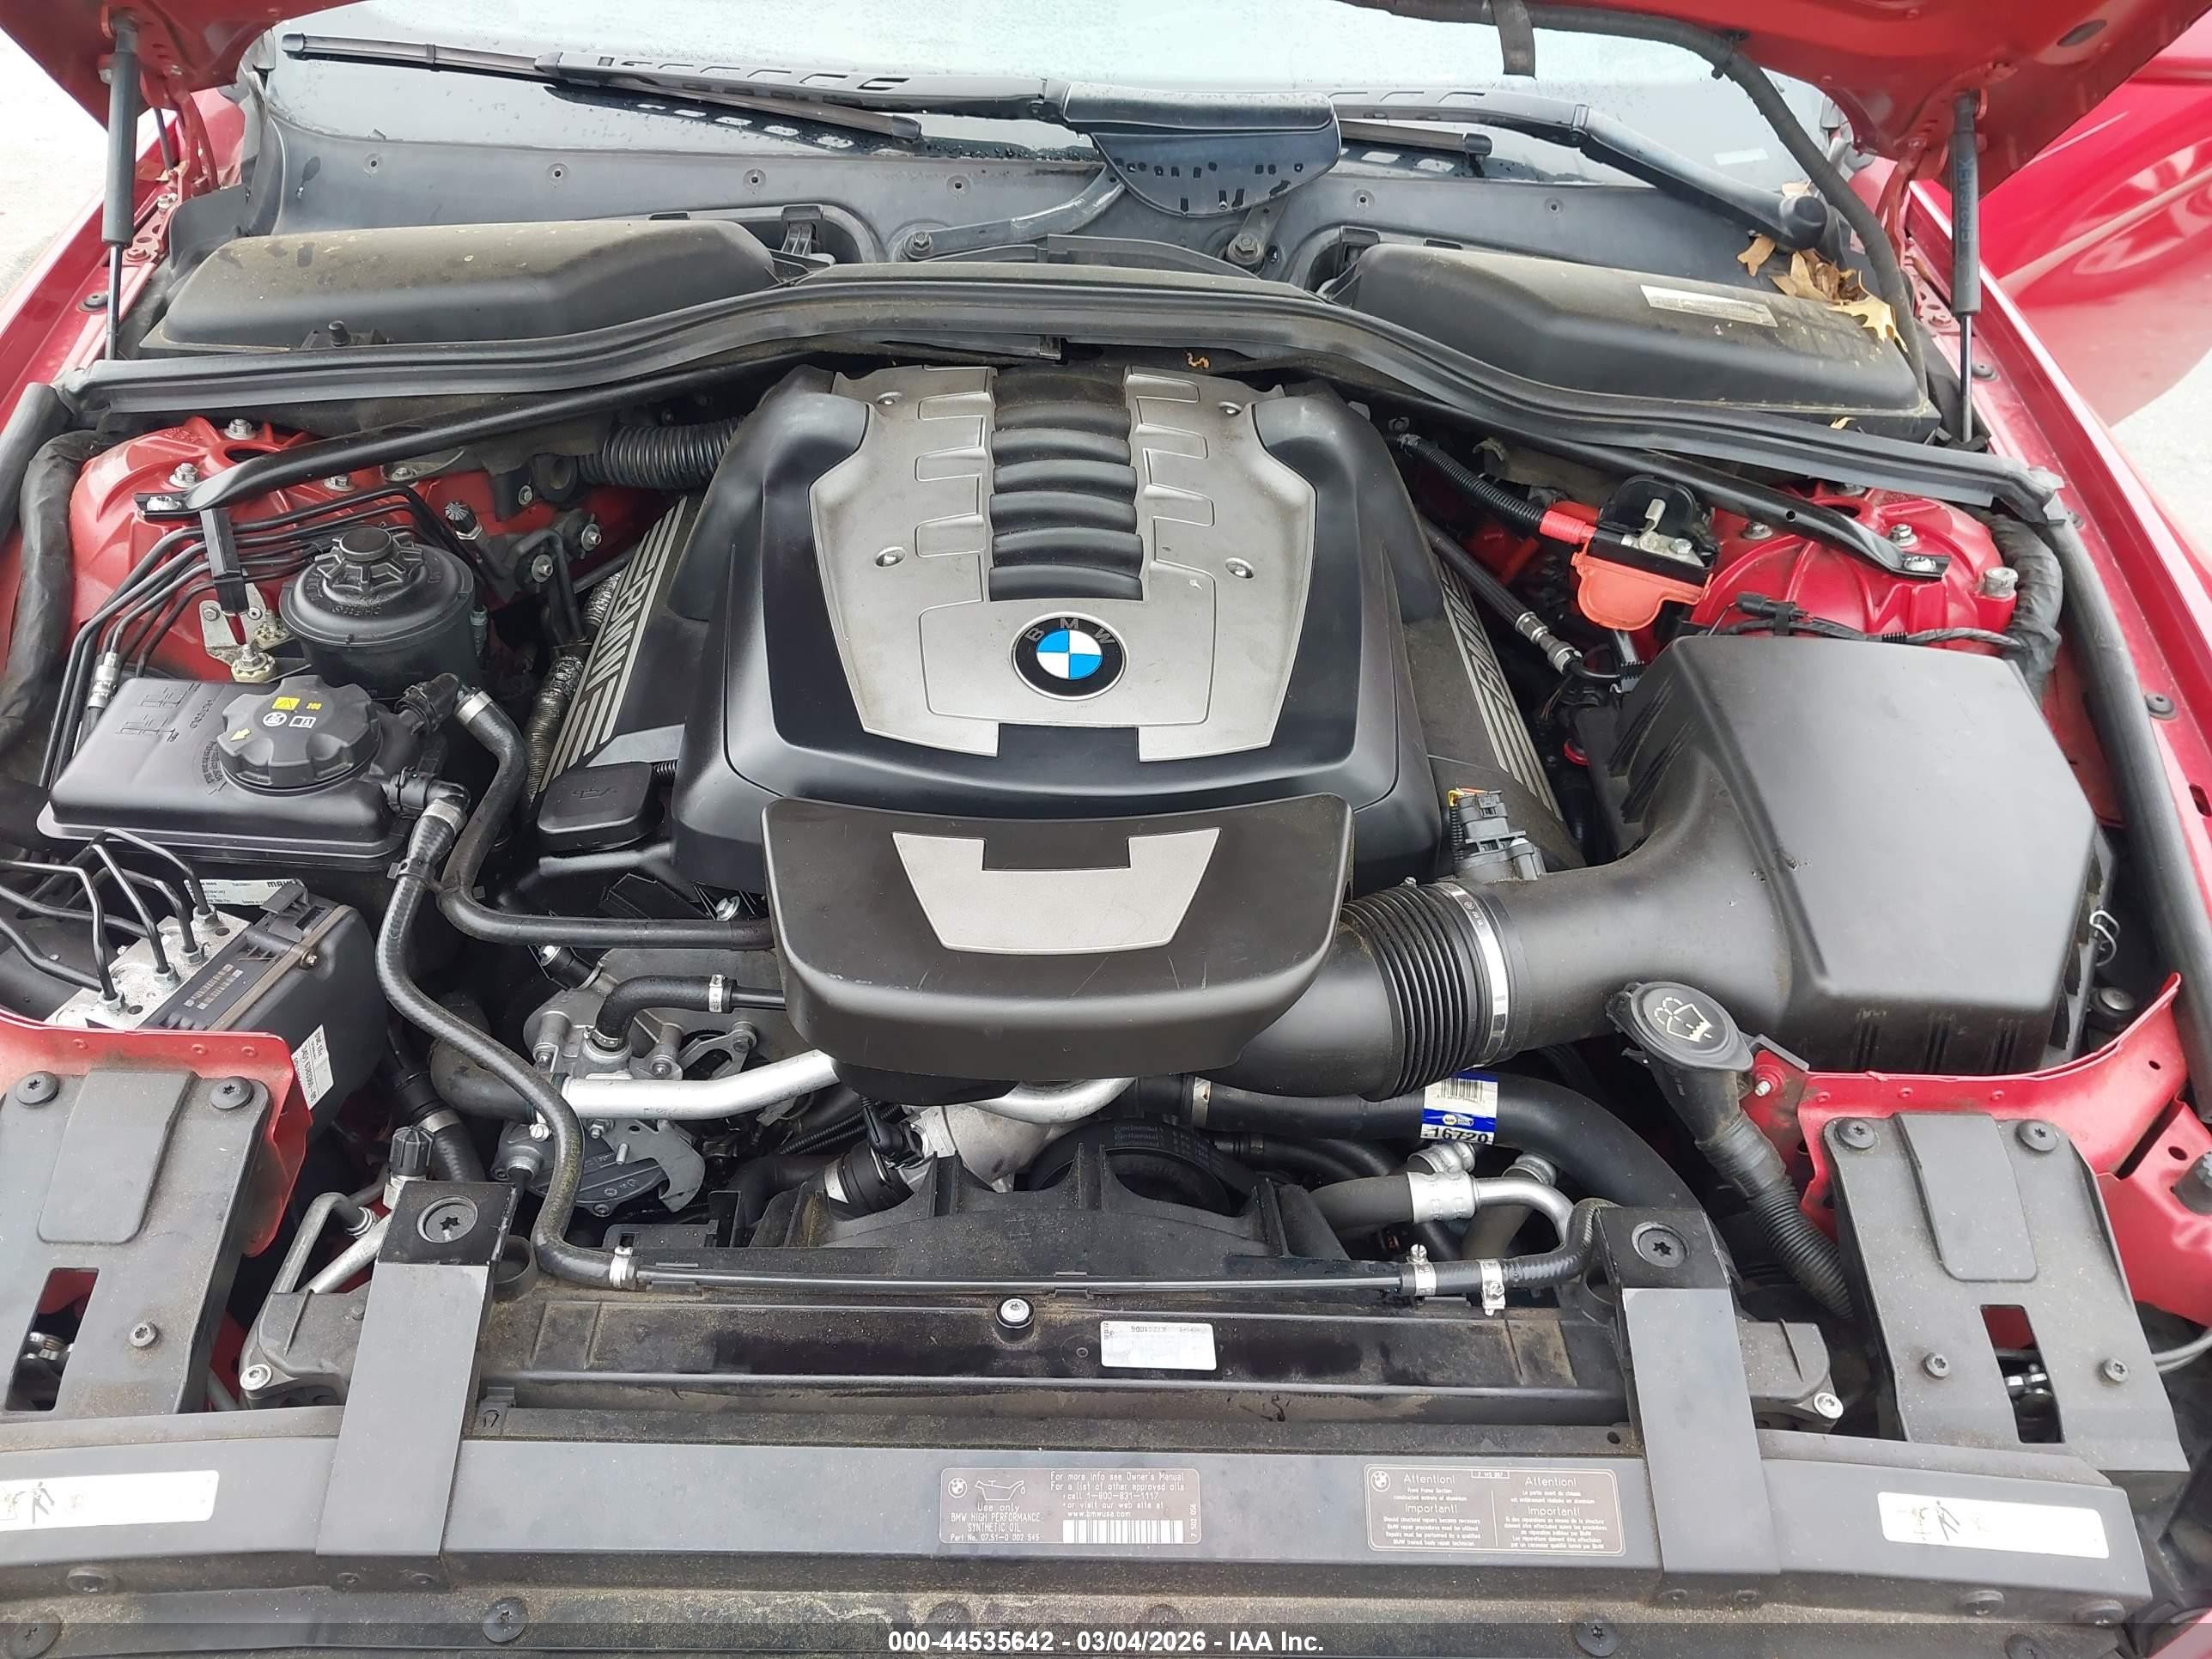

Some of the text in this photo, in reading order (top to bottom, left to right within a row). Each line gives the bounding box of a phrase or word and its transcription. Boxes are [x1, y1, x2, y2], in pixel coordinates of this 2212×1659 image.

[1024, 617, 1115, 645] BMW
[1050, 1471, 1184, 1481] For more info see Owner's Manual
[1403, 1474, 1455, 1485] Attention!
[1050, 1481, 1063, 1491] For
[1077, 1481, 1090, 1491] list
[1095, 1481, 1103, 1491] of
[1108, 1482, 1127, 1491] other
[1132, 1482, 1165, 1492] approved
[1524, 1476, 1577, 1487] Attention!
[977, 1503, 1019, 1513] Use only
[1405, 1504, 1457, 1514] Important!
[1528, 1504, 1580, 1516] Important!
[951, 1513, 1040, 1522] BMW HIGH PERFORMANCE
[969, 1522, 1021, 1532] SYNTHETIC OIL
